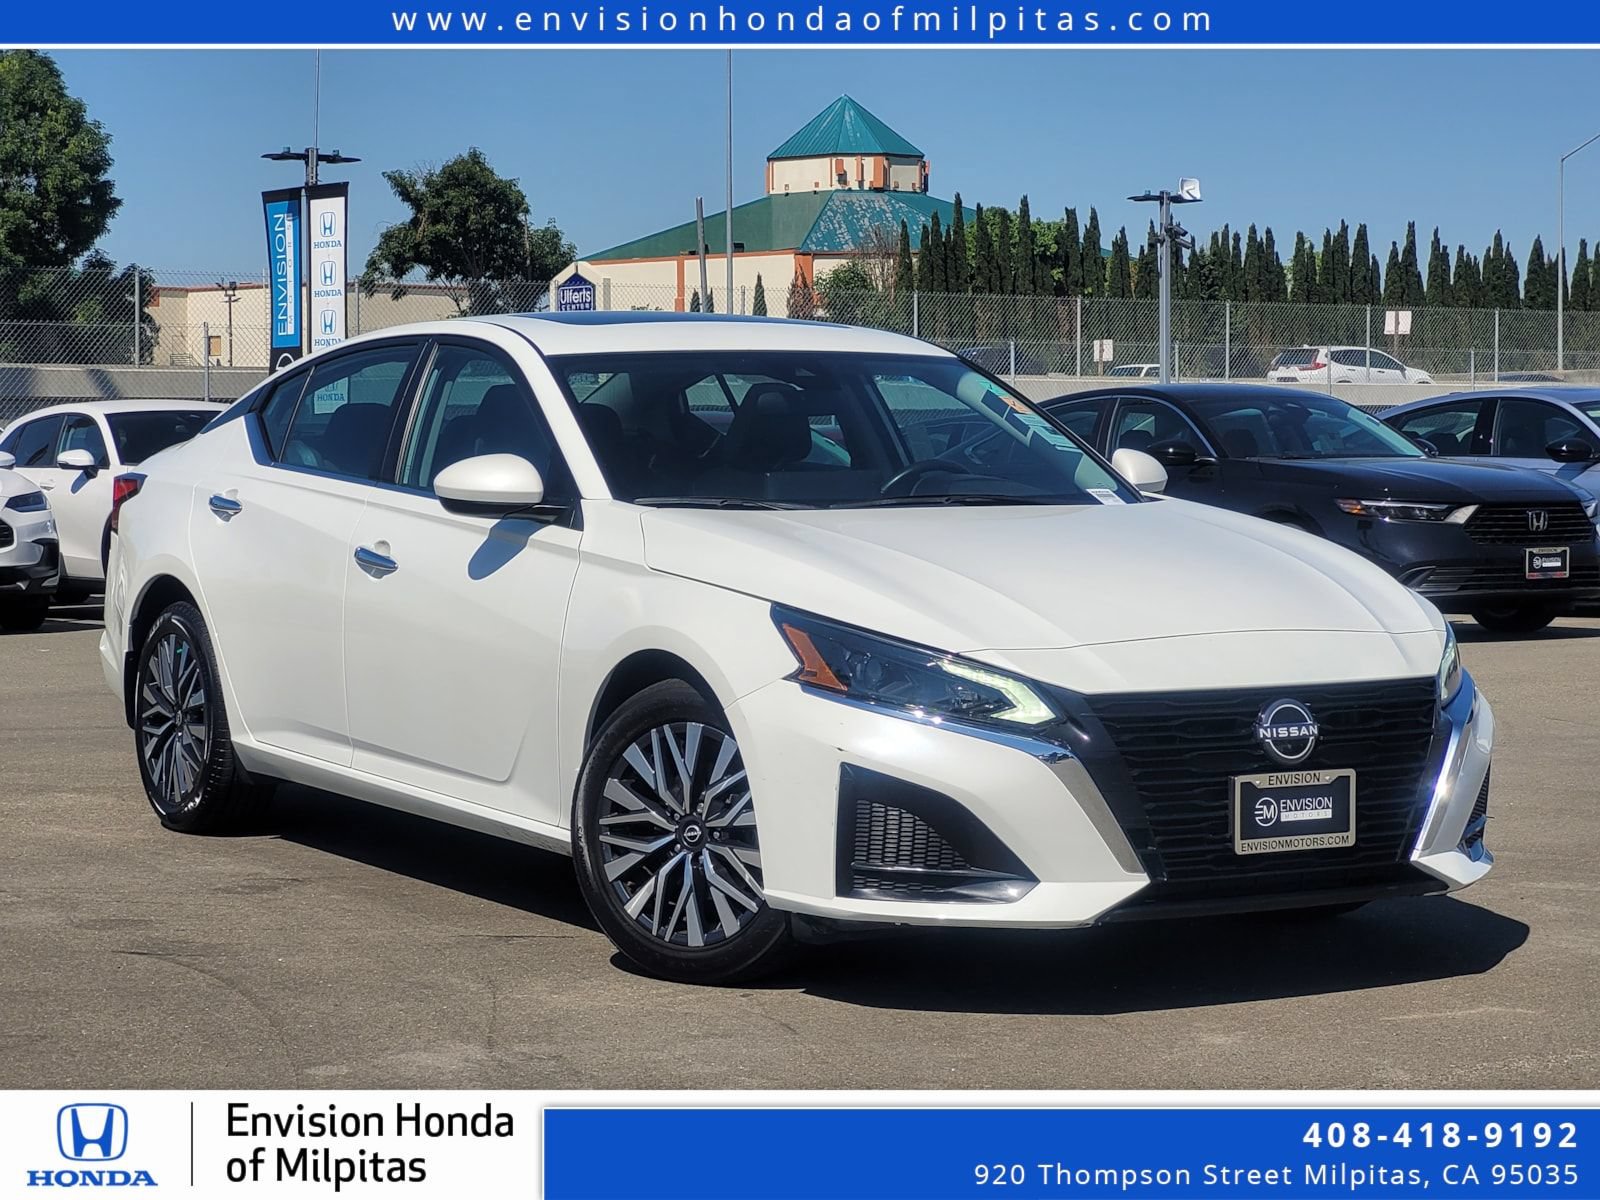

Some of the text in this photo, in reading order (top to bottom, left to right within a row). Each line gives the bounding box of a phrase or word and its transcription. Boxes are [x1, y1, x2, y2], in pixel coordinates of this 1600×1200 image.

[313, 240, 342, 249] HONDA
[273, 213, 288, 336] ENVISION
[313, 289, 343, 298] HONDA
[1259, 724, 1318, 739] NISSAN
[1268, 772, 1321, 786] ENVISION
[1280, 796, 1333, 812] ENVISION
[1284, 811, 1329, 819] MOTORS
[1241, 835, 1350, 852] ENVISIONMOTORS.COM
